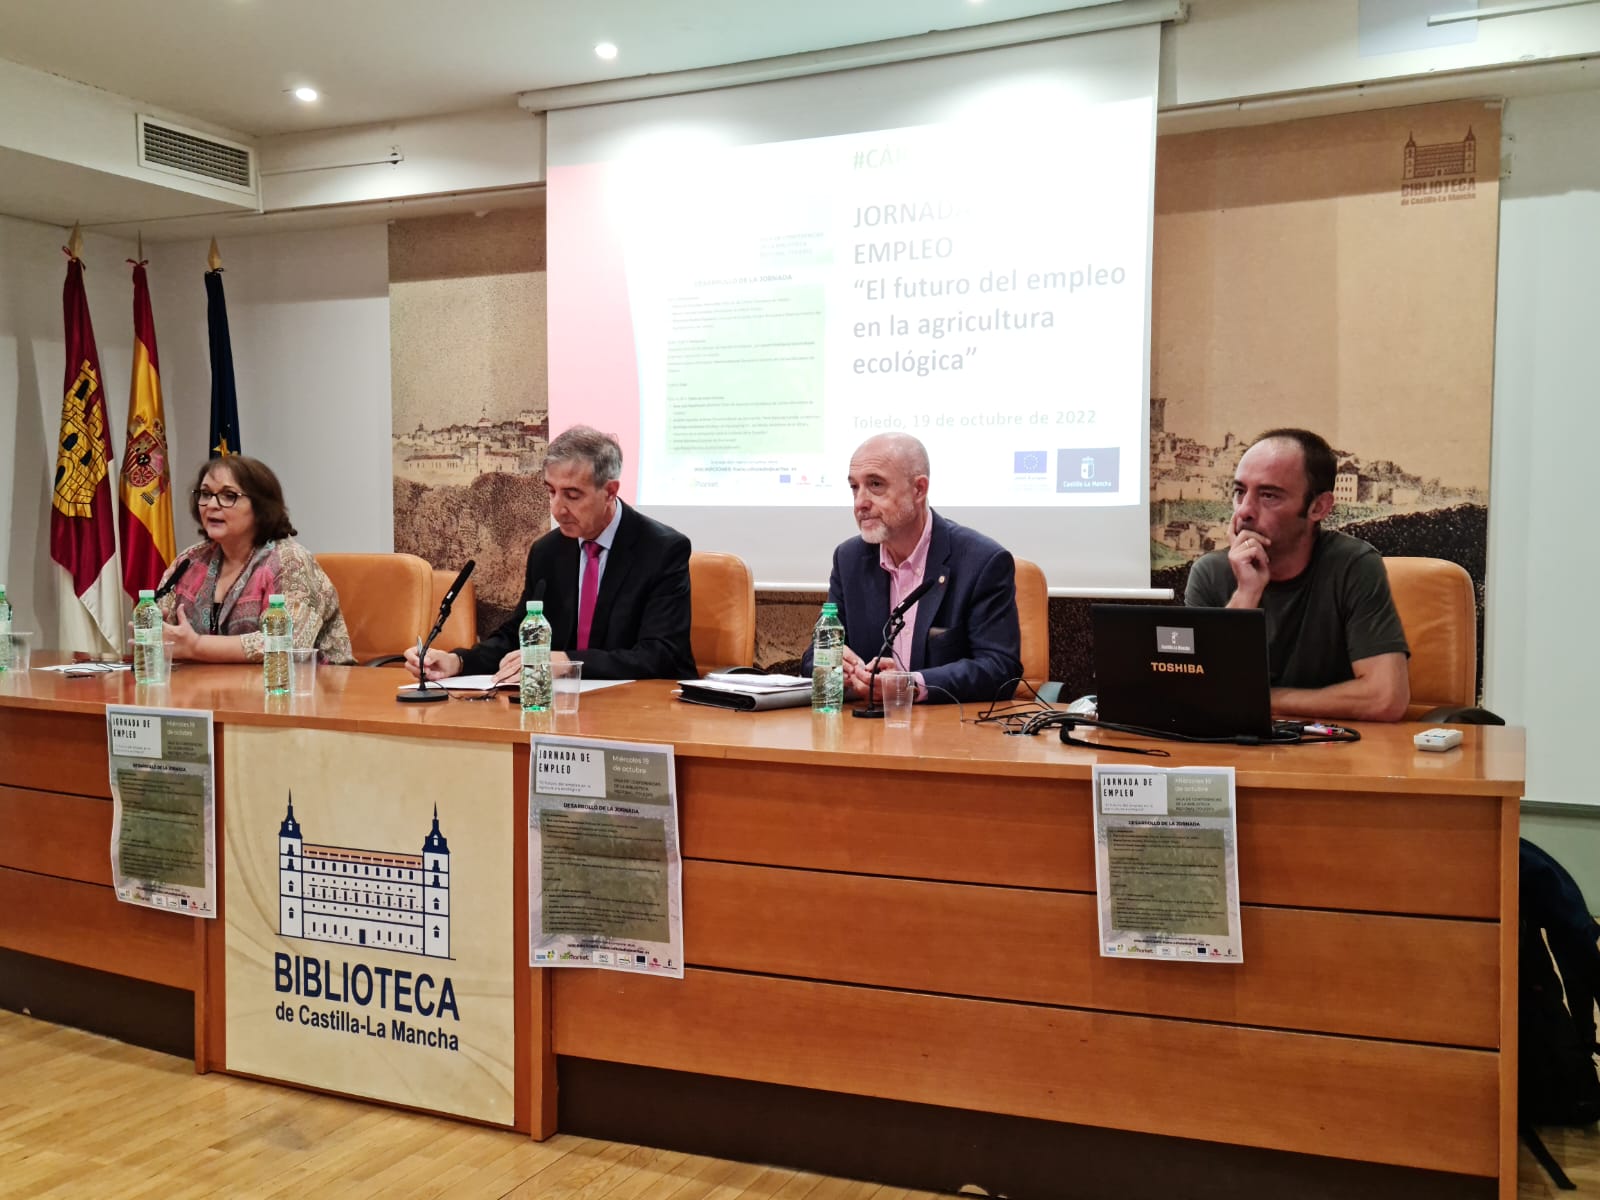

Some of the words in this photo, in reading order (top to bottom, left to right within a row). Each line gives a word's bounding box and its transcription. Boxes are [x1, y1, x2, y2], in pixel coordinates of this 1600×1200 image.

[1401, 177, 1476, 197] BIBLIOTECA
[854, 236, 953, 264] EMPLEO
[894, 276, 970, 299] futuro
[979, 269, 1017, 294] del
[1027, 264, 1125, 293] empleo
[853, 320, 881, 338] en
[889, 315, 909, 336] la
[918, 308, 1054, 339] agricultura
[853, 414, 907, 430] Toledo,
[913, 414, 931, 428] 19
[935, 412, 954, 427] de
[959, 411, 1022, 427] octubre
[1029, 410, 1050, 425] de
[1055, 409, 1097, 424] 2022
[1151, 661, 1204, 674] TOSHIBA
[112, 717, 139, 727] JORNADA
[143, 719, 150, 728] DE
[113, 729, 136, 739] EMPLEO
[539, 750, 576, 762] JORNADA
[580, 753, 591, 763] DE
[539, 763, 571, 775] EMPLEO
[1103, 778, 1139, 786] JORNADA
[1143, 778, 1153, 786] DE
[1103, 788, 1134, 798] EMPLEO
[274, 951, 460, 1021] BIBLIOTECA
[275, 1000, 294, 1023] de
[299, 1004, 386, 1039] Castilla-La
[391, 1019, 459, 1051] Mancha
